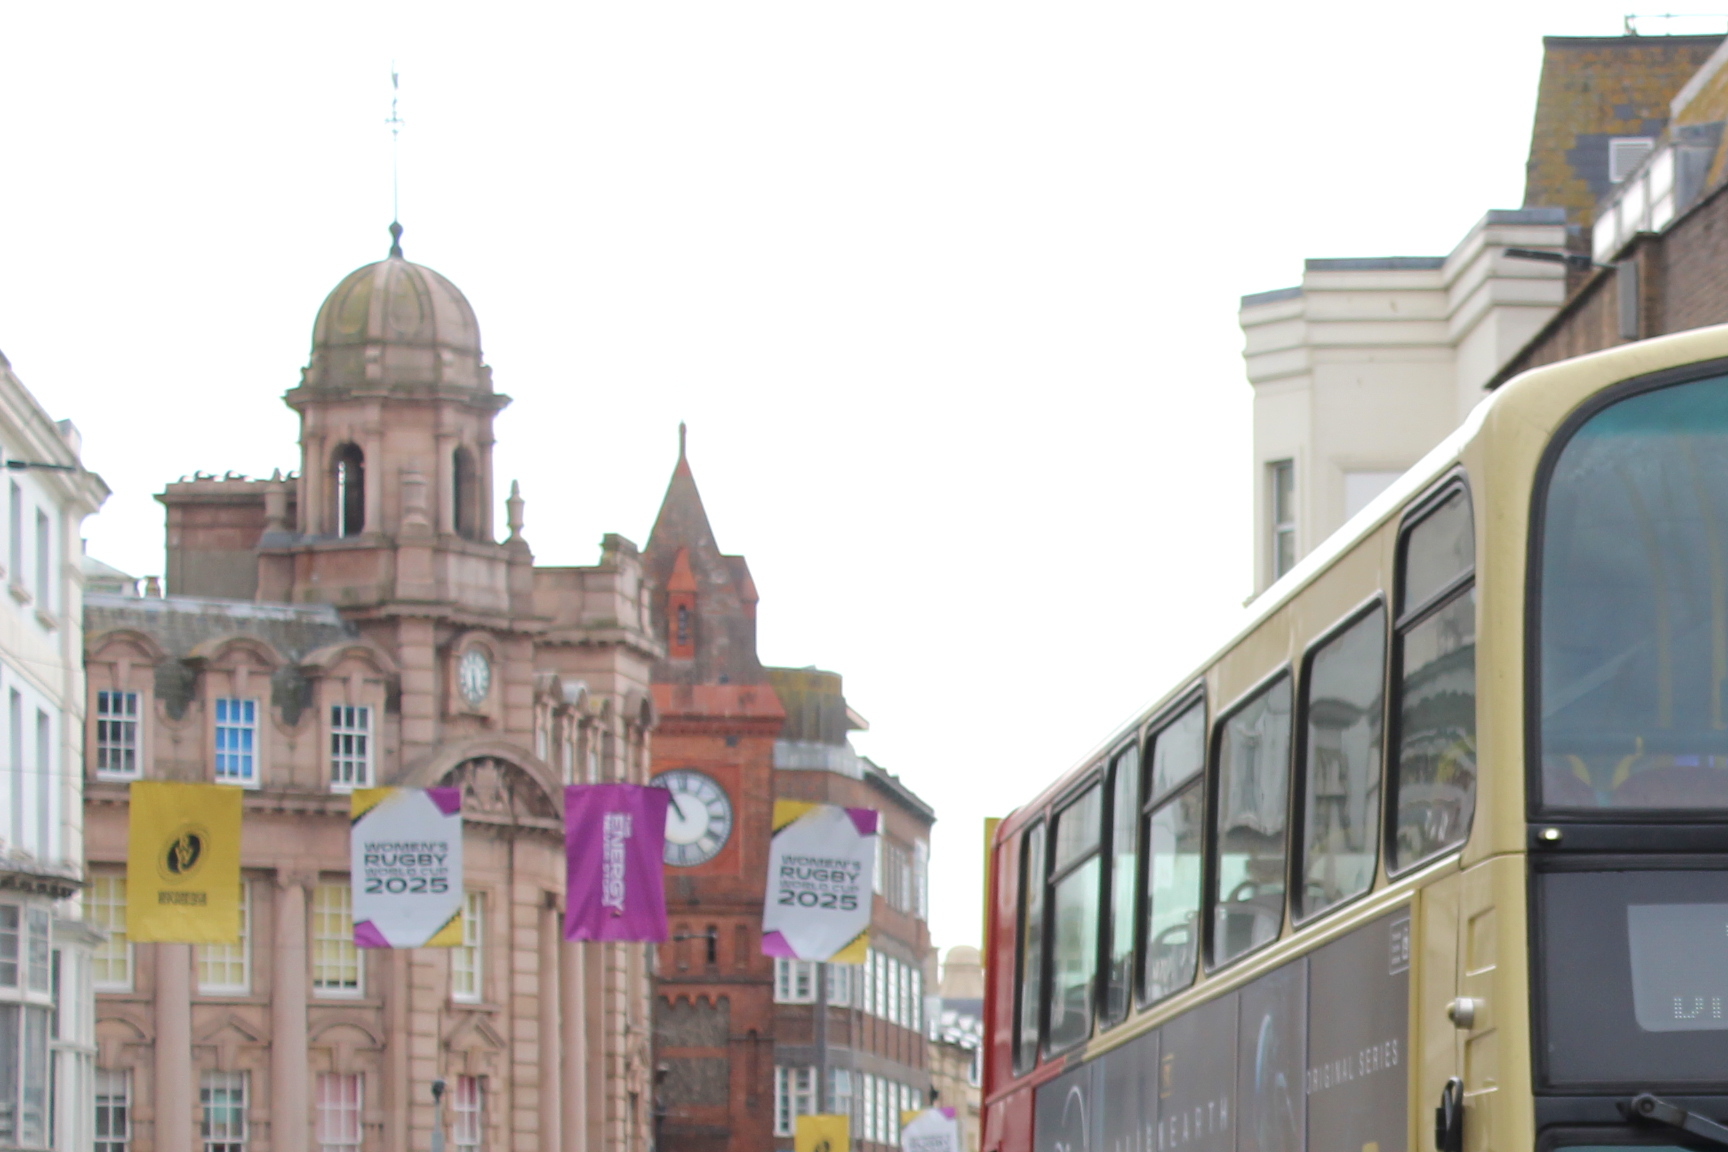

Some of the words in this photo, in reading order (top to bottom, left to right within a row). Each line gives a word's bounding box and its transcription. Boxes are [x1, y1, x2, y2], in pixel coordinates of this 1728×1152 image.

[364, 842, 449, 852] WOMEN'S
[364, 853, 448, 867] RUGBY
[610, 813, 626, 911] ENERGY
[781, 855, 861, 870] WOMEN'S
[365, 867, 416, 876] WORLD
[420, 868, 449, 876] CUP
[780, 866, 860, 884] RUGBY
[365, 877, 449, 894] 2025
[779, 880, 829, 892] WORLD
[832, 884, 860, 893] CUP
[778, 889, 858, 911] 2025
[1306, 1056, 1354, 1095] ORIGINAL
[1358, 1039, 1399, 1076] SERIES
